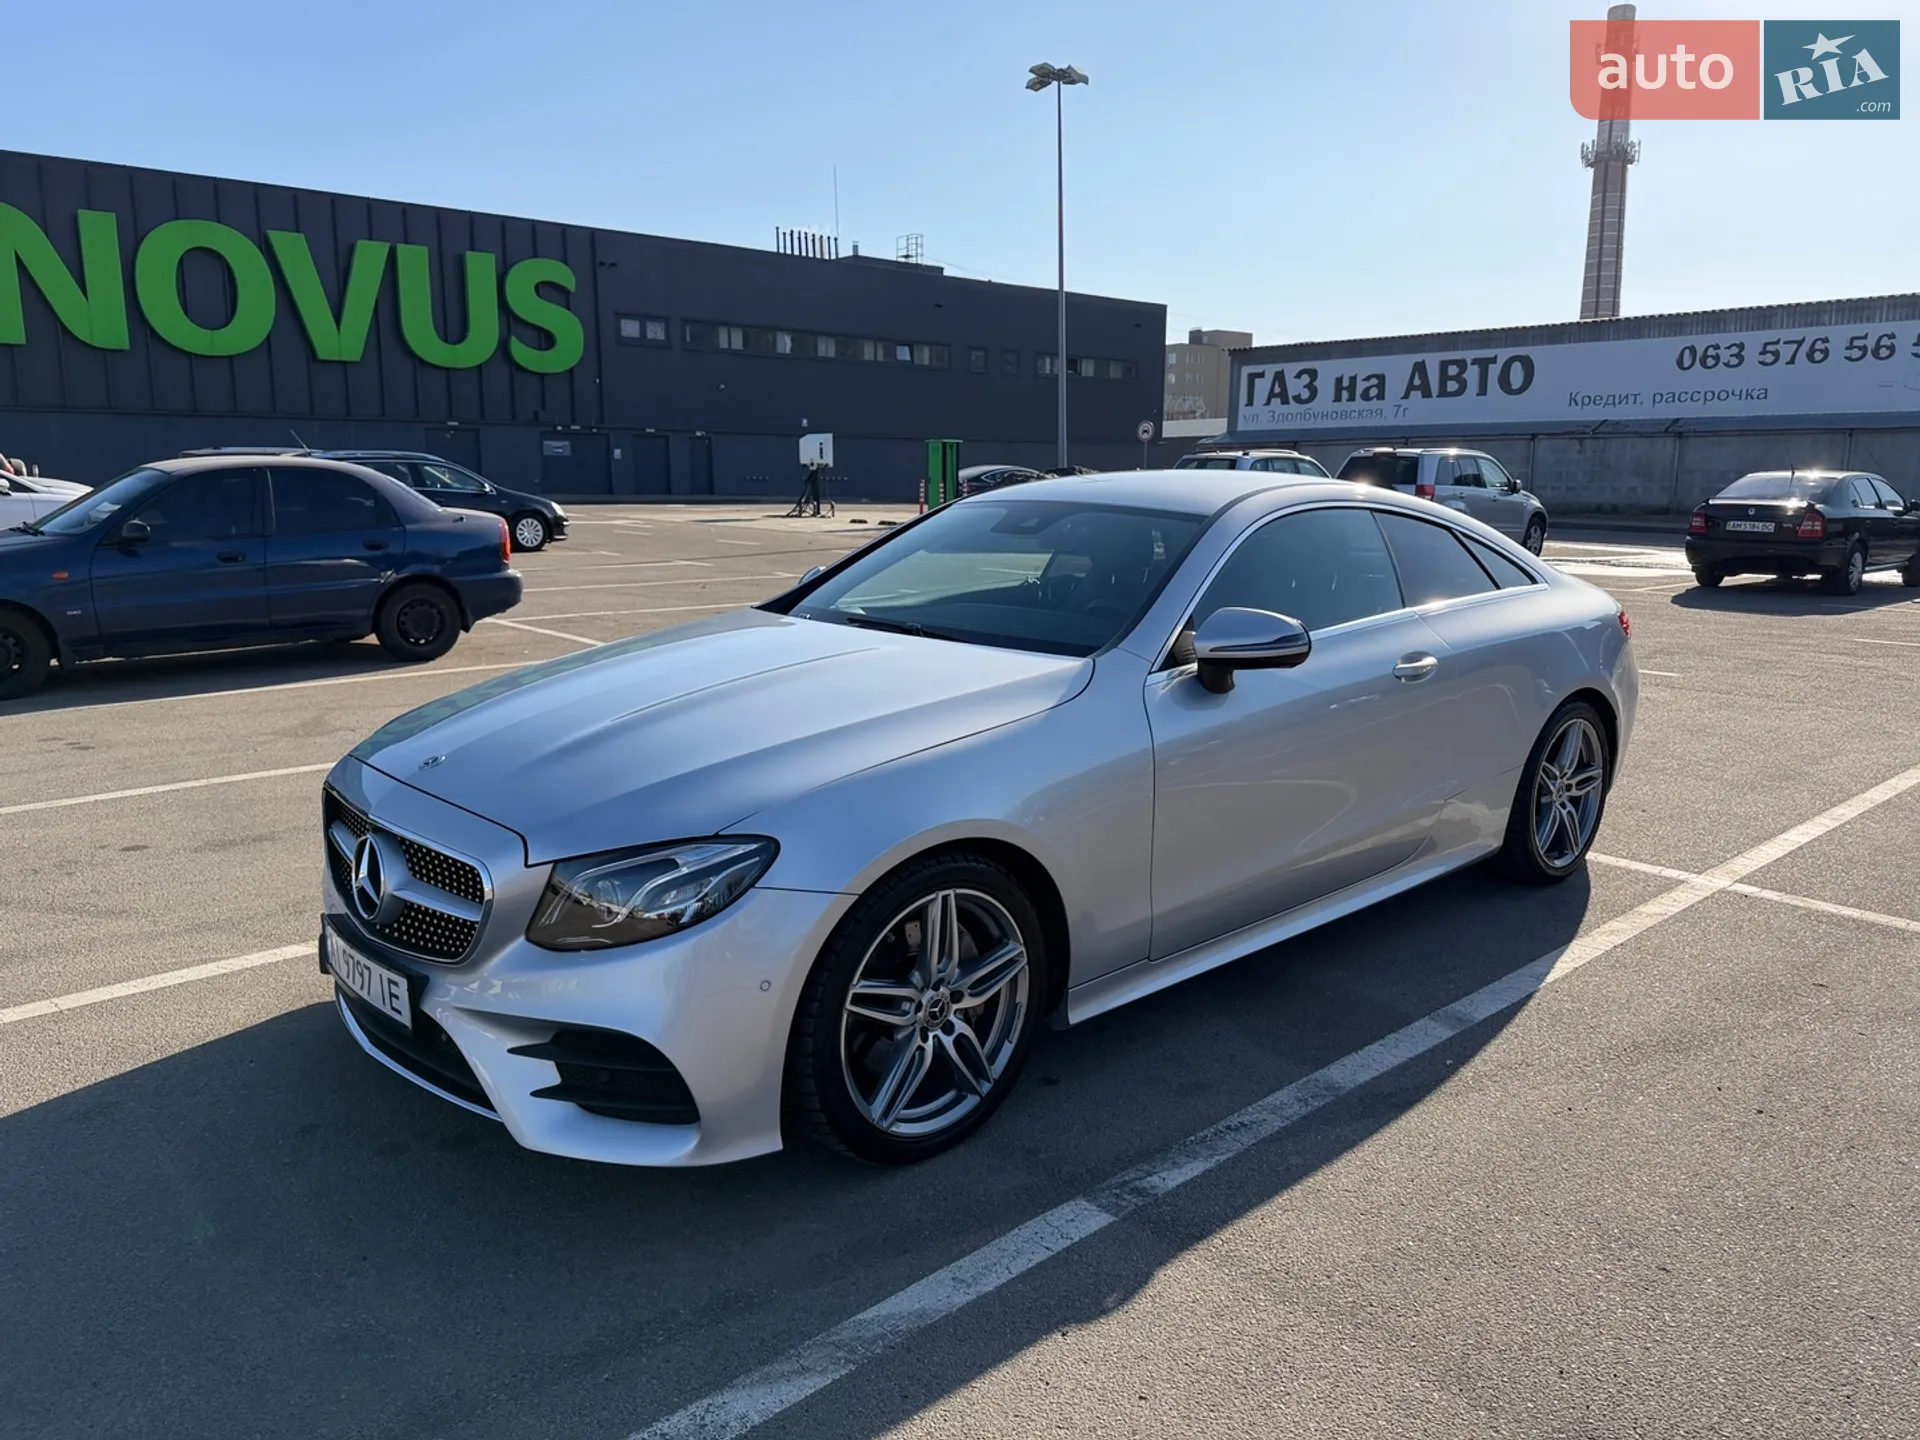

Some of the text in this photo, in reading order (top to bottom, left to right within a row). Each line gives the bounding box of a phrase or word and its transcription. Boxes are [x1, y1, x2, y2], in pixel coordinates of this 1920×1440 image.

[0, 204, 584, 373] NOVUS
[1676, 341, 1745, 371] 063
[1757, 335, 1830, 366] 576
[1843, 332, 1896, 362] 56
[1244, 353, 1535, 407] ГАЗ на АВТО
[1568, 385, 1768, 409] Кредит, рассрочка
[1243, 413, 1263, 426] ул.
[1267, 406, 1388, 425] Здолбуновская,
[343, 948, 371, 997] 9797
[379, 973, 403, 1016] IE
